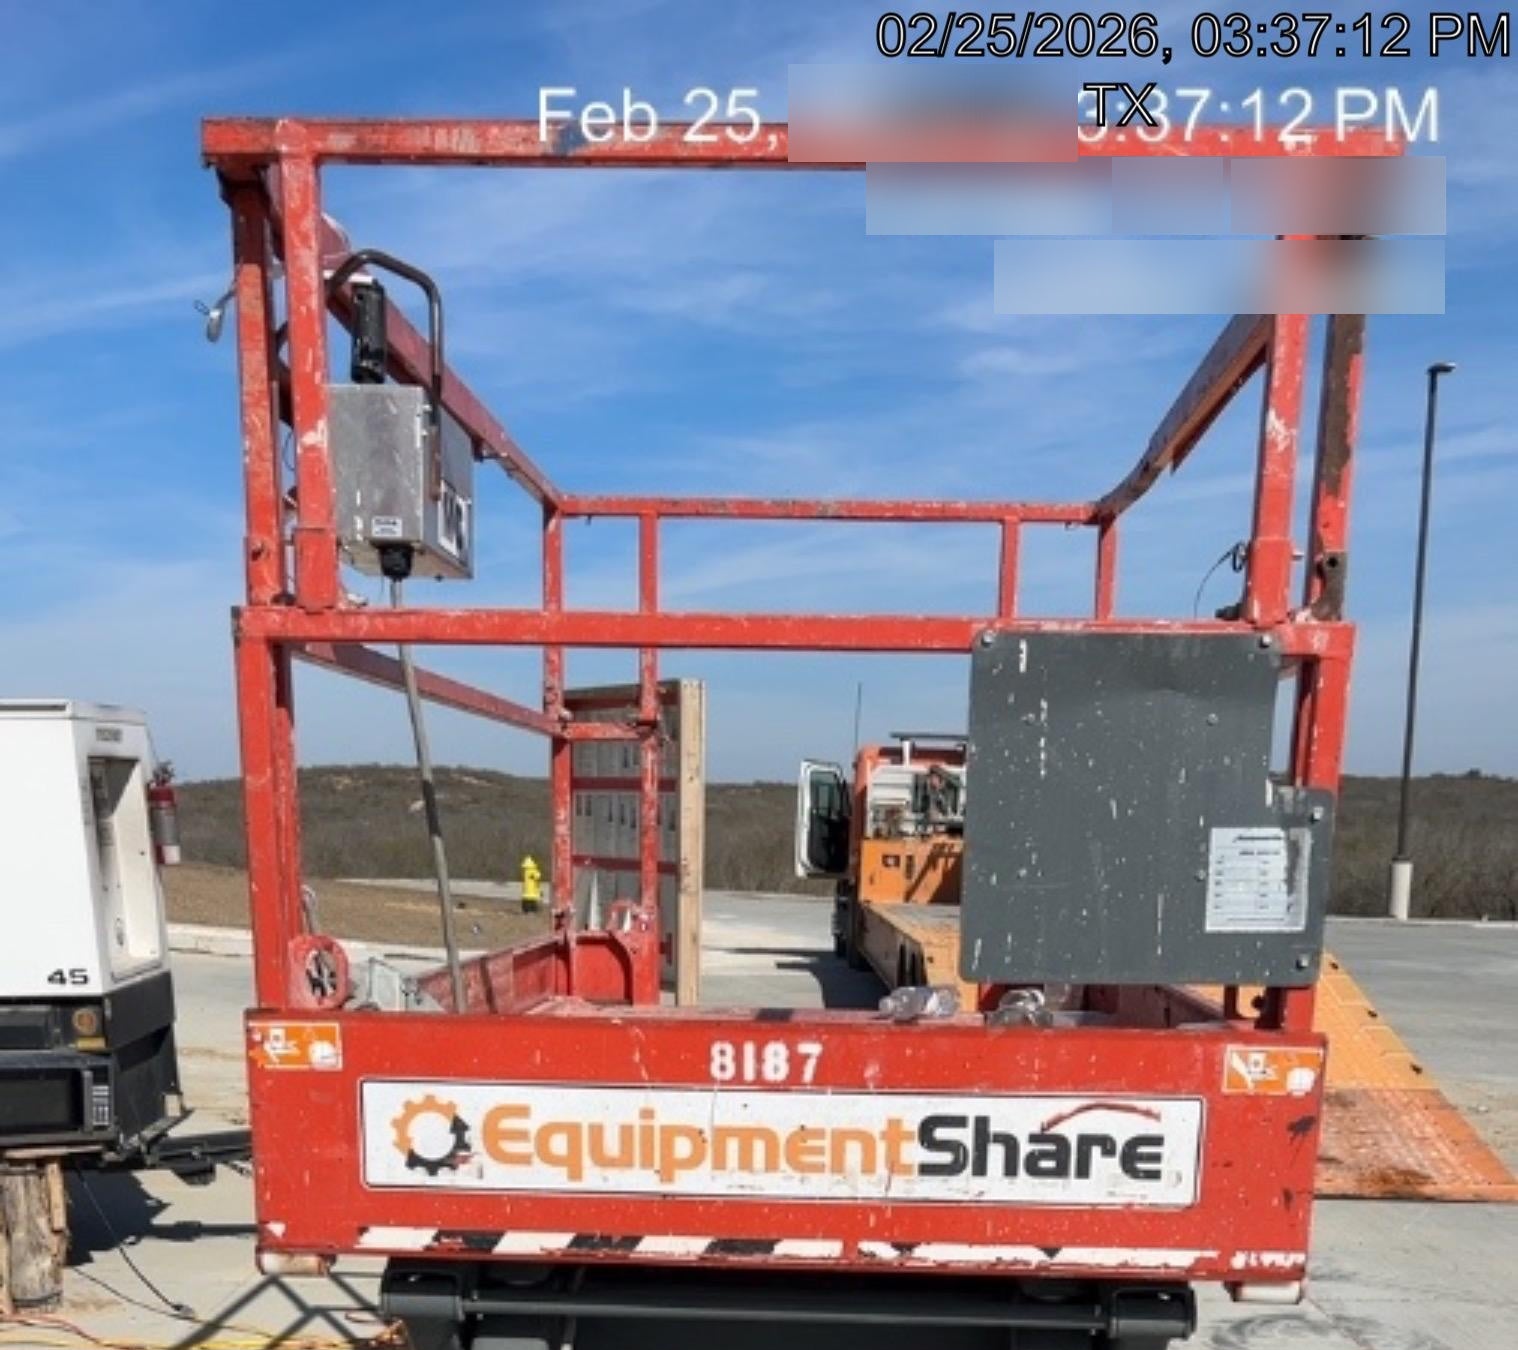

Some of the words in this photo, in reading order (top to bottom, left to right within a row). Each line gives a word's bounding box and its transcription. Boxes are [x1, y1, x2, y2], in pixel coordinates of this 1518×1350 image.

[47, 968, 89, 985] 45
[710, 1040, 823, 1083] 8187
[482, 1104, 1164, 1182] EquipmentShare
